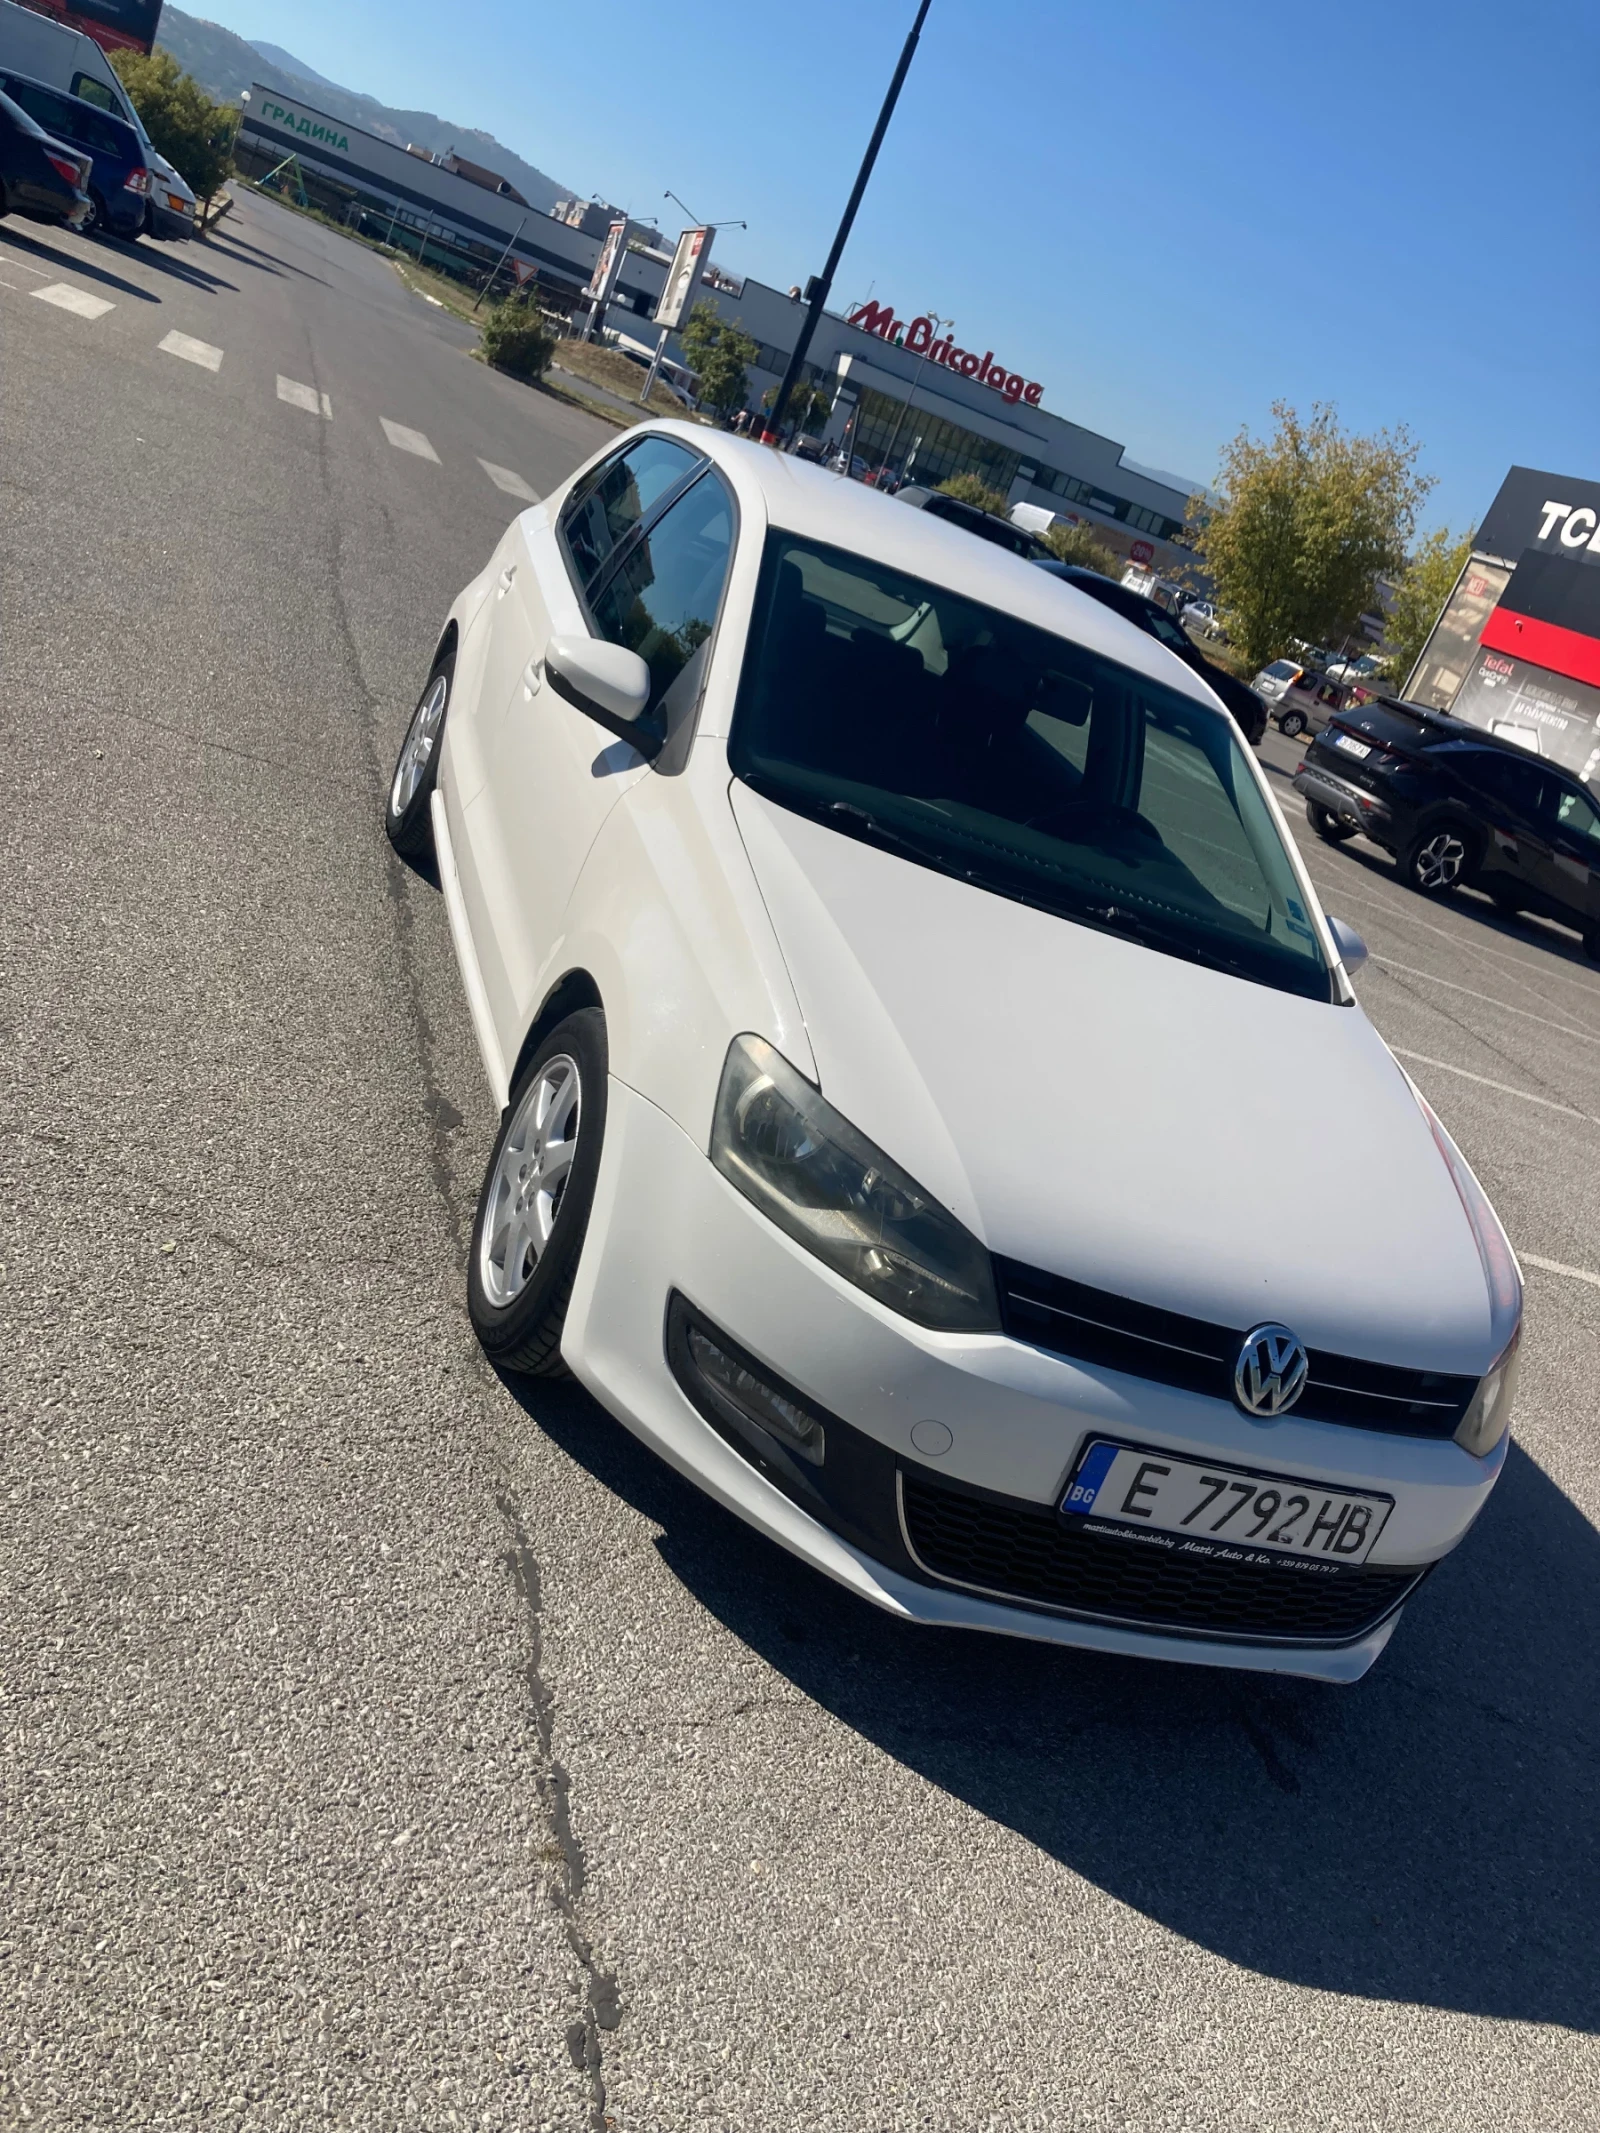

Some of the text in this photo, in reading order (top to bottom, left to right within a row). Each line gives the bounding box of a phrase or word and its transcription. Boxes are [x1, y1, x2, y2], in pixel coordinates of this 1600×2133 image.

[261, 100, 349, 152] ГРАДИНА
[1483, 654, 1515, 676] Tefal
[1070, 1485, 1096, 1504] BG
[1120, 1462, 1171, 1517] E
[1213, 1548, 1244, 1561] Auto
[1245, 1553, 1254, 1562] &
[1255, 1554, 1271, 1565] Ko.
[1276, 1558, 1295, 1568] +359
[1308, 1564, 1321, 1572] 05
